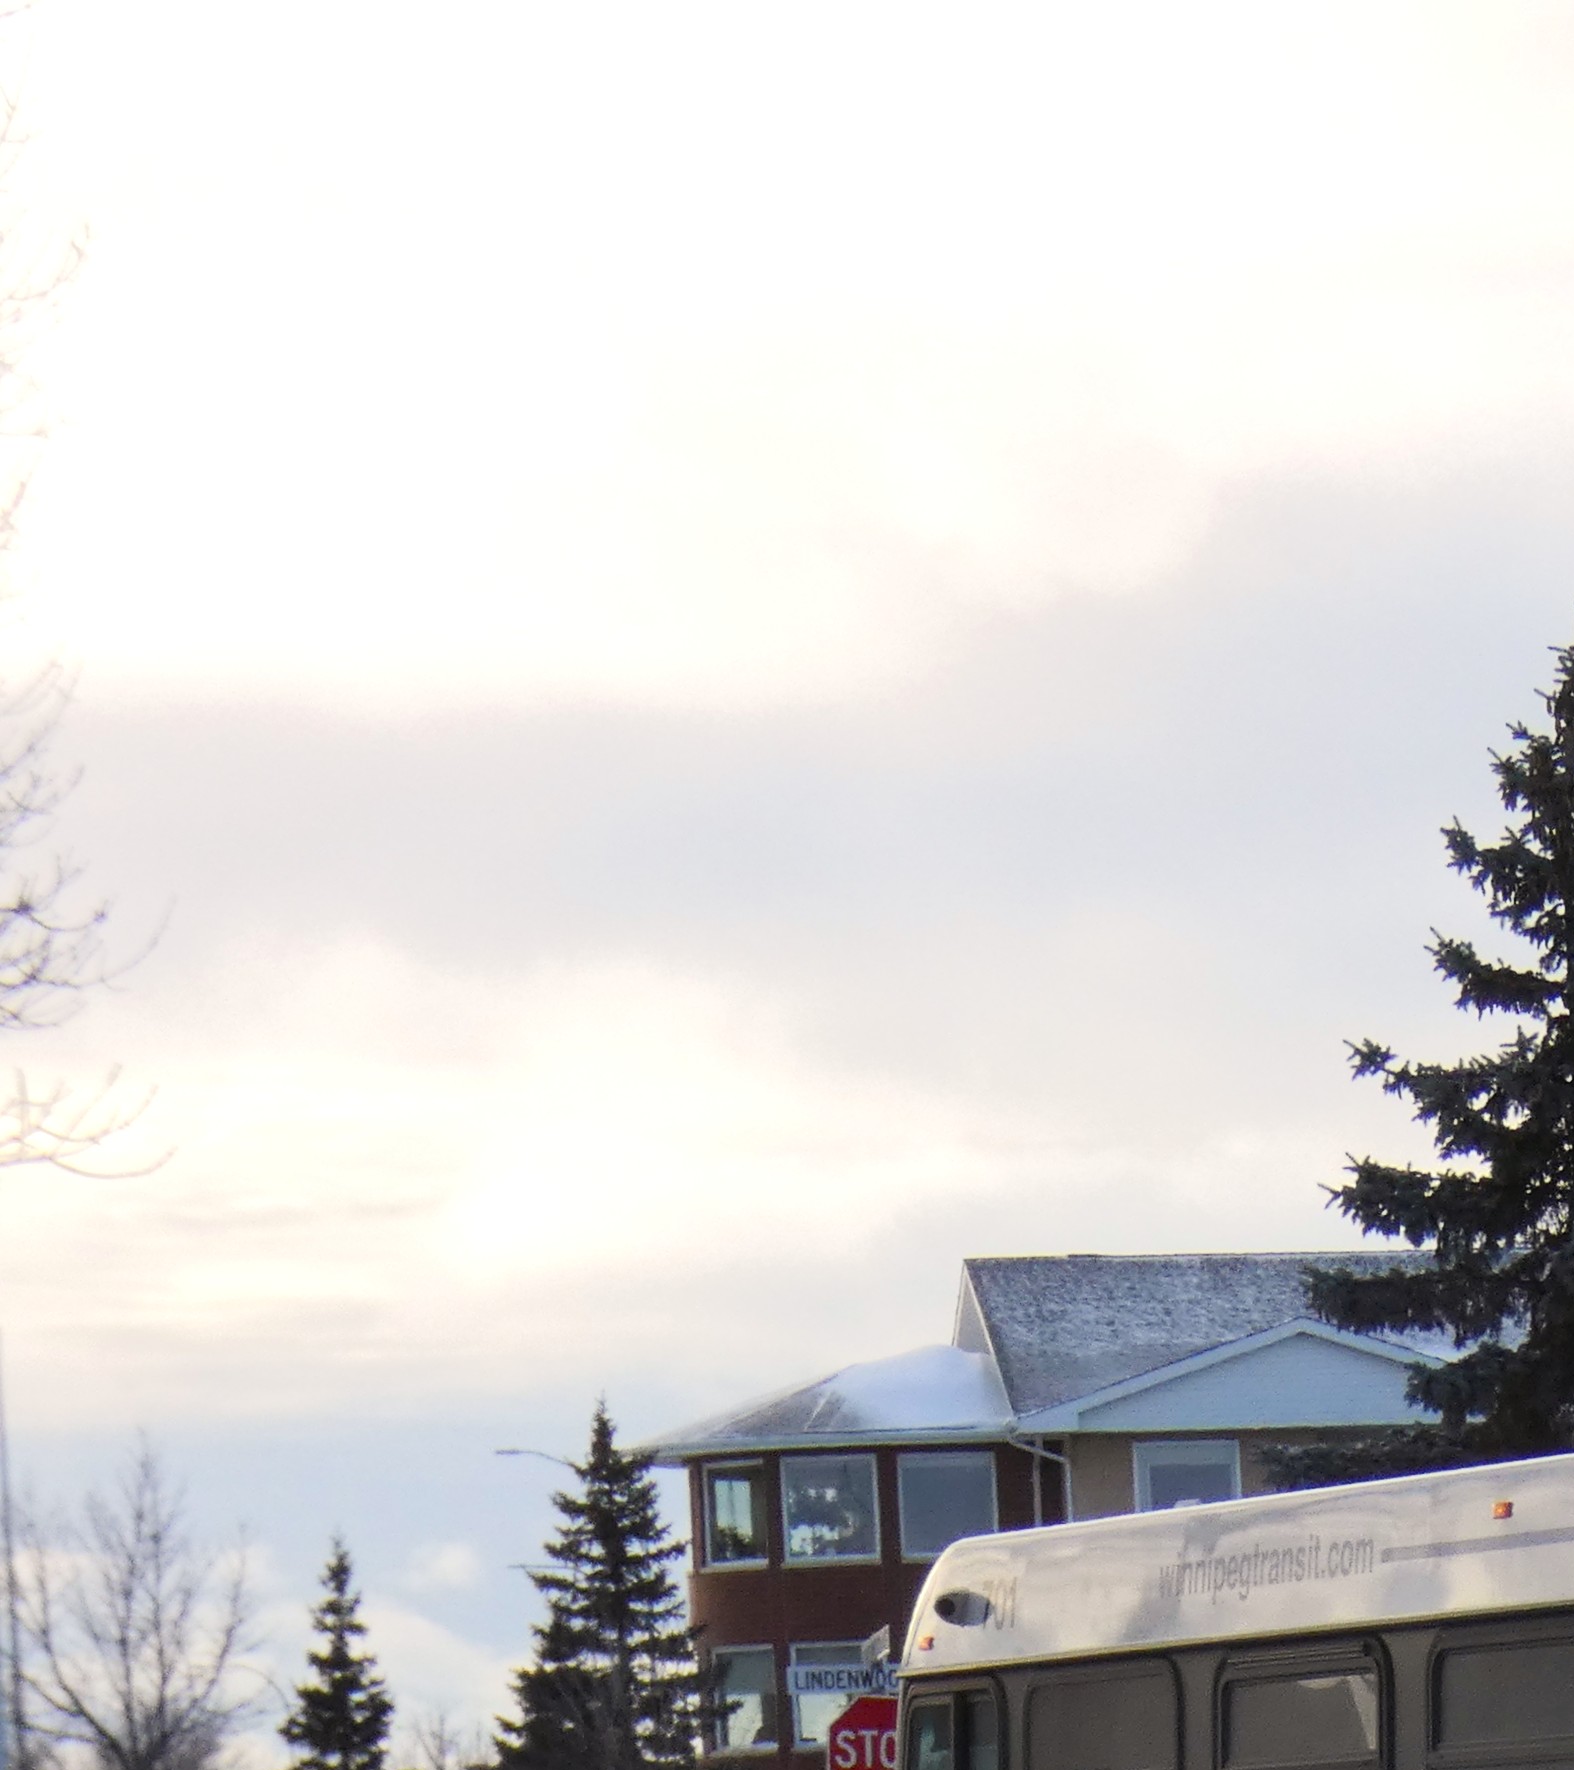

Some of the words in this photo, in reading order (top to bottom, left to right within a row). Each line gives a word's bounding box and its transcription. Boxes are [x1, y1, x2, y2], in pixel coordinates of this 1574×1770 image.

[1157, 1532, 1376, 1605] winnipegtransit.com
[794, 1667, 900, 1691] LINDENWOO
[834, 1729, 898, 1770] STO
